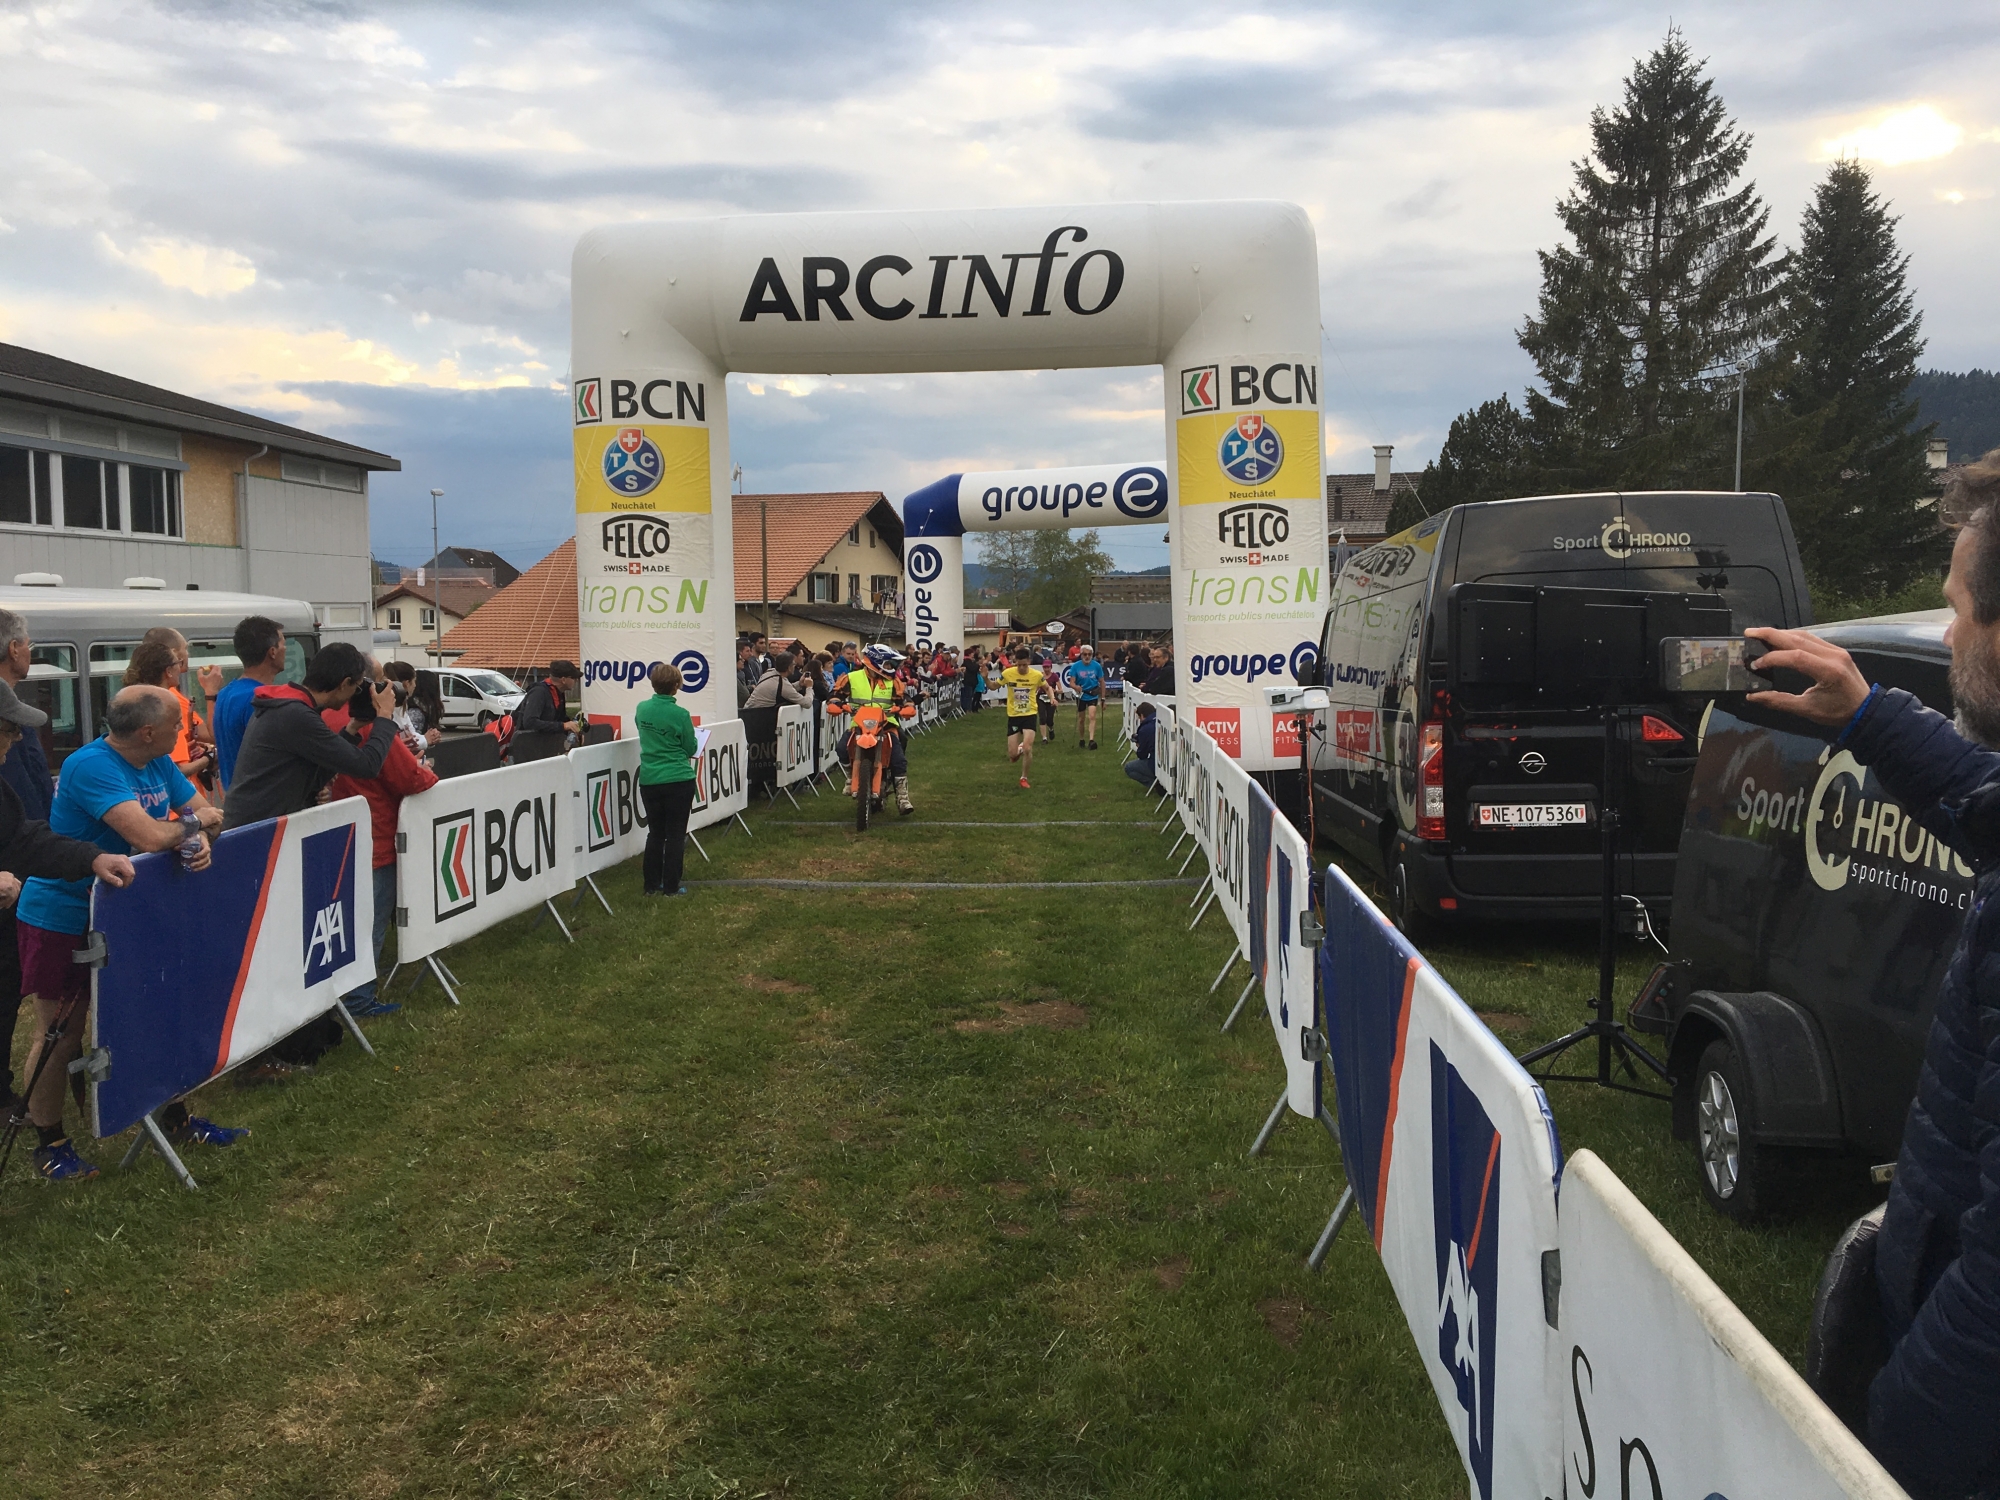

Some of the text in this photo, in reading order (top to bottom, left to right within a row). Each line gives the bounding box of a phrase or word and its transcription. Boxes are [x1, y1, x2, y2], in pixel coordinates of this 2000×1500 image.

[611, 379, 705, 421] BCN
[1230, 363, 1317, 406] BCN
[611, 502, 656, 510] Neuchâtel
[982, 481, 1107, 521] groupe
[1229, 490, 1276, 499] Neuchâtel
[602, 514, 670, 558] FELCO
[1219, 503, 1290, 548] FELCO
[1553, 535, 1598, 552] Sport
[1220, 554, 1290, 564] SWISS MADE
[611, 620, 641, 629] publics
[1187, 613, 1226, 623] transports
[1229, 612, 1262, 622] publics
[1191, 653, 1286, 683] groupe
[796, 721, 811, 766] BCN
[1199, 720, 1238, 733] ACTIV
[709, 742, 740, 802] BCN
[618, 765, 649, 836] BC
[1737, 777, 1804, 836] Sport
[485, 793, 556, 896] BCN
[1223, 797, 1244, 911] BCN
[304, 900, 348, 971] AXA
